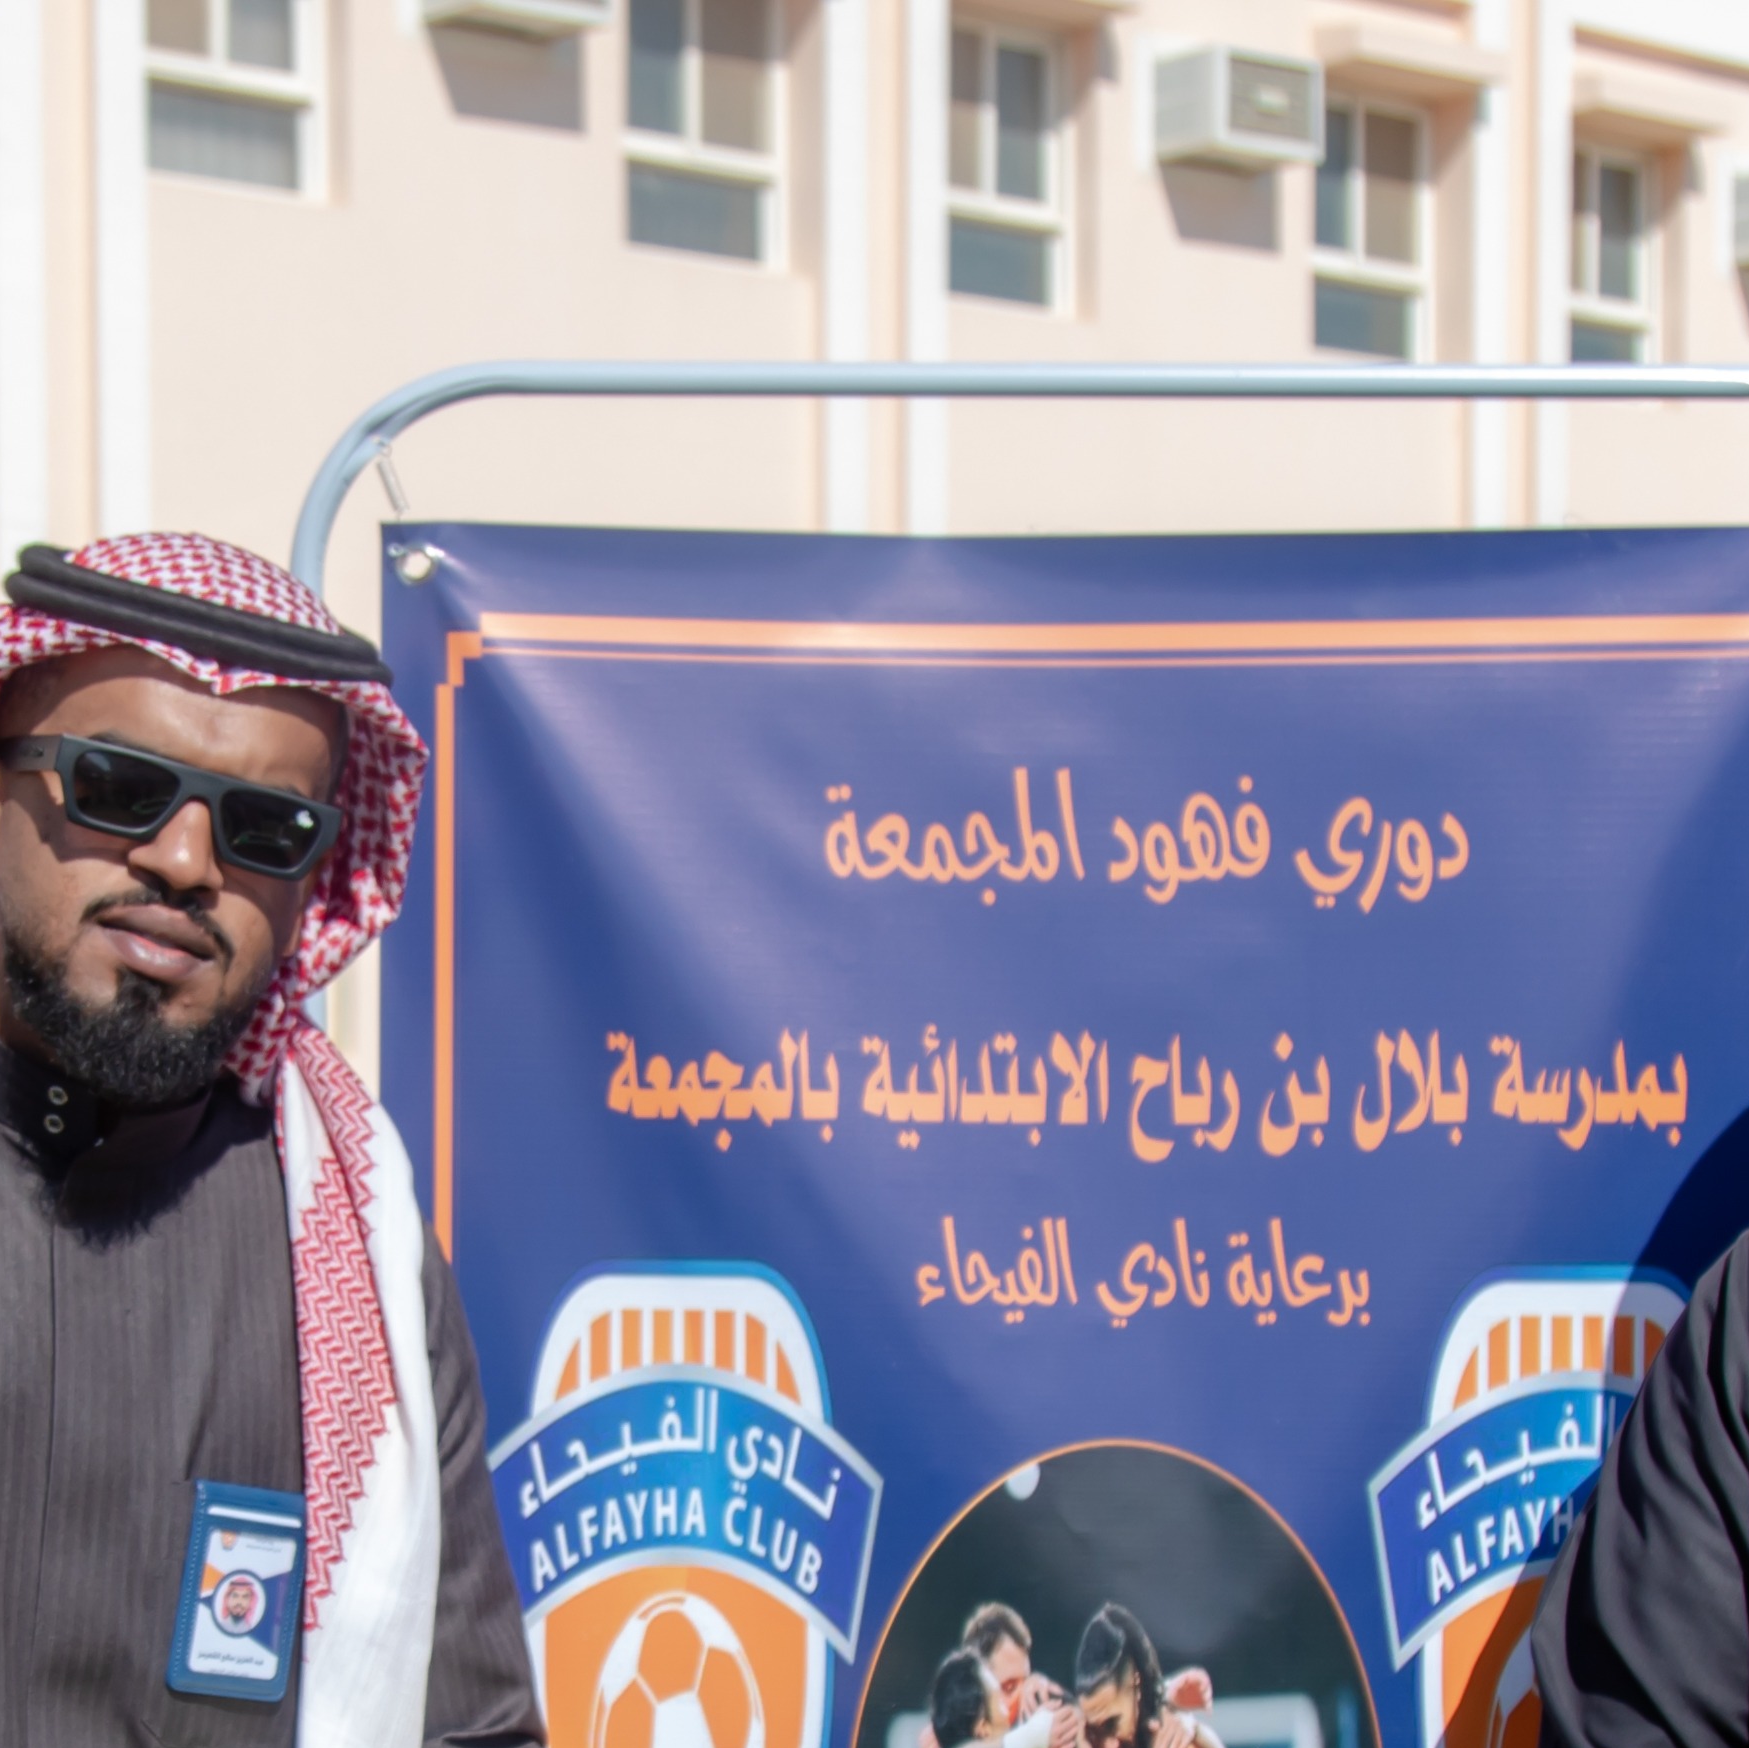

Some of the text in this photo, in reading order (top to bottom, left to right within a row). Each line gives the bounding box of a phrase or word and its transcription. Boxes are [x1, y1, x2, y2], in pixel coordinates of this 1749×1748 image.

[825, 767, 1469, 912] دوري فهود المجمعة
[607, 1024, 1688, 1162] بمدرسة بلال بن رباح الابتدائية بالمجمعة
[916, 1216, 1370, 1328] برعاية نادي الفيحاء
[520, 1386, 842, 1520] نادي الفيحاء
[531, 1487, 823, 1595] ALFAYHA CLUB
[1427, 1495, 1575, 1606] ALFAYH
